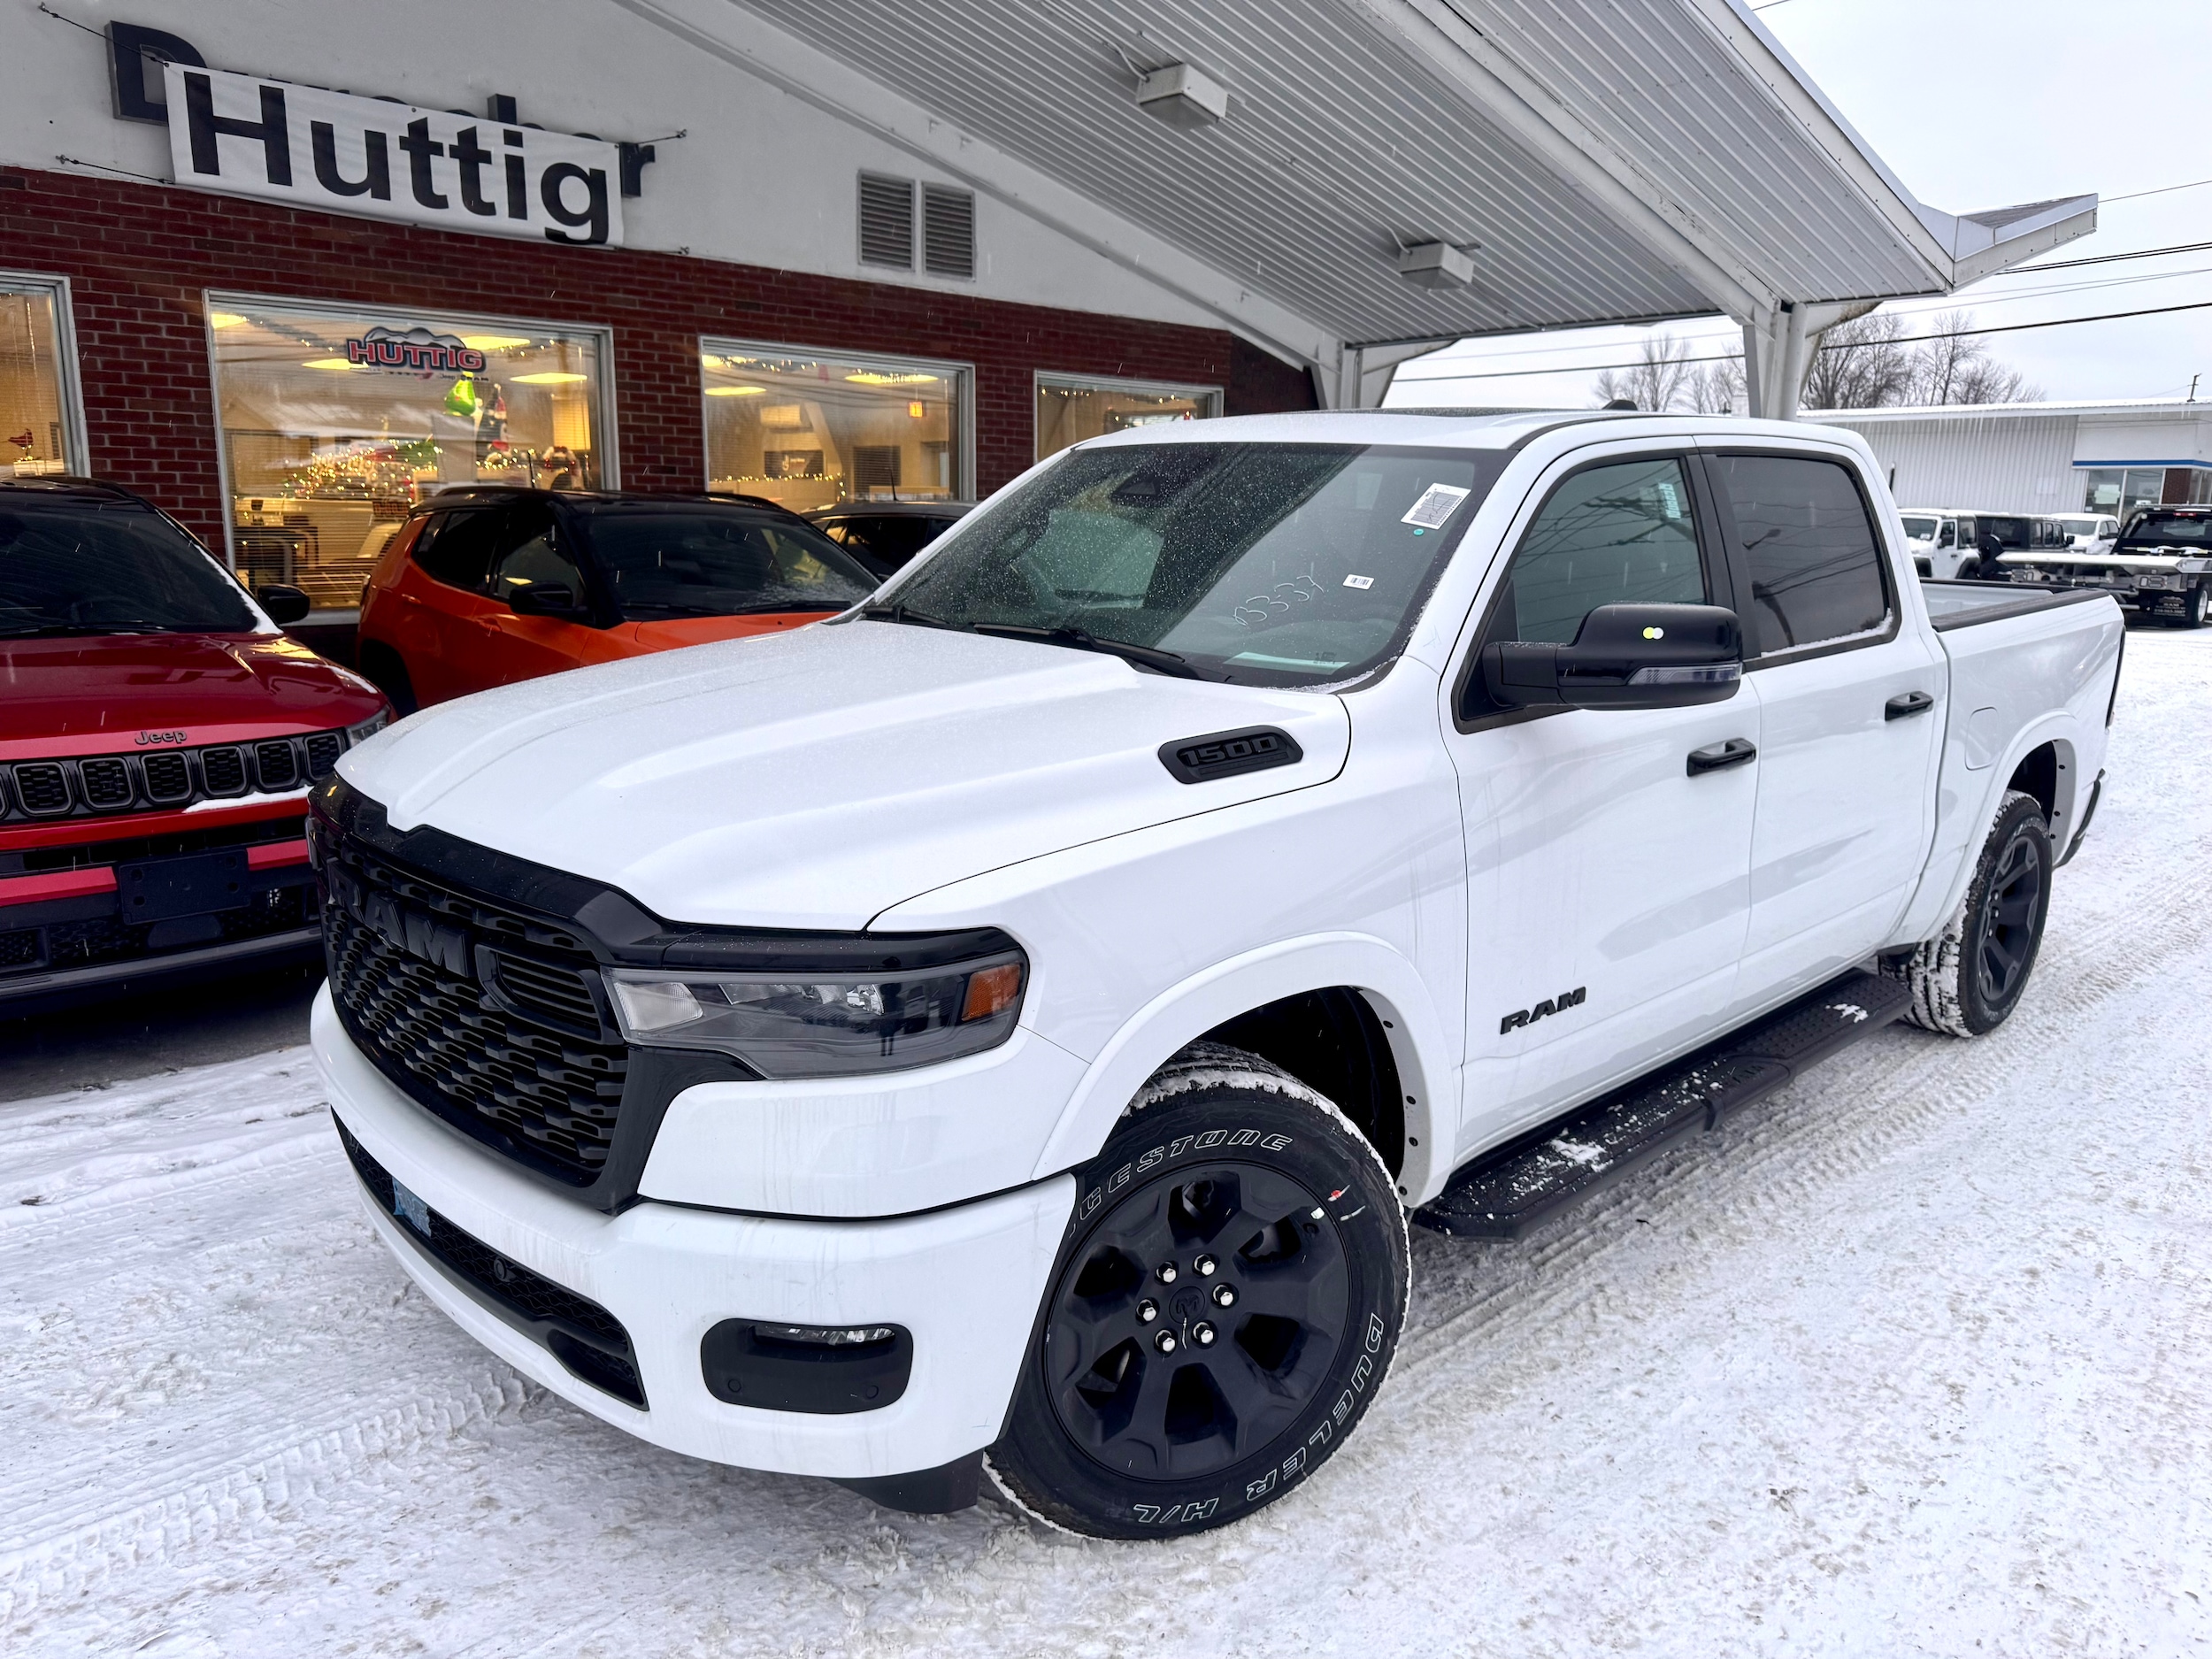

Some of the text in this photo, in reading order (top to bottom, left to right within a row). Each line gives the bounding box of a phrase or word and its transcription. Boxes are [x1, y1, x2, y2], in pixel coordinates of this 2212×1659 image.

[183, 71, 611, 245] Huttig
[348, 340, 484, 370] HUTTIG
[134, 731, 187, 745] Jeep
[1179, 735, 1279, 767] 1500
[326, 856, 469, 978] RAM
[1500, 986, 1586, 1035] RAM
[1133, 1312, 1385, 1524] DUELER H/L
